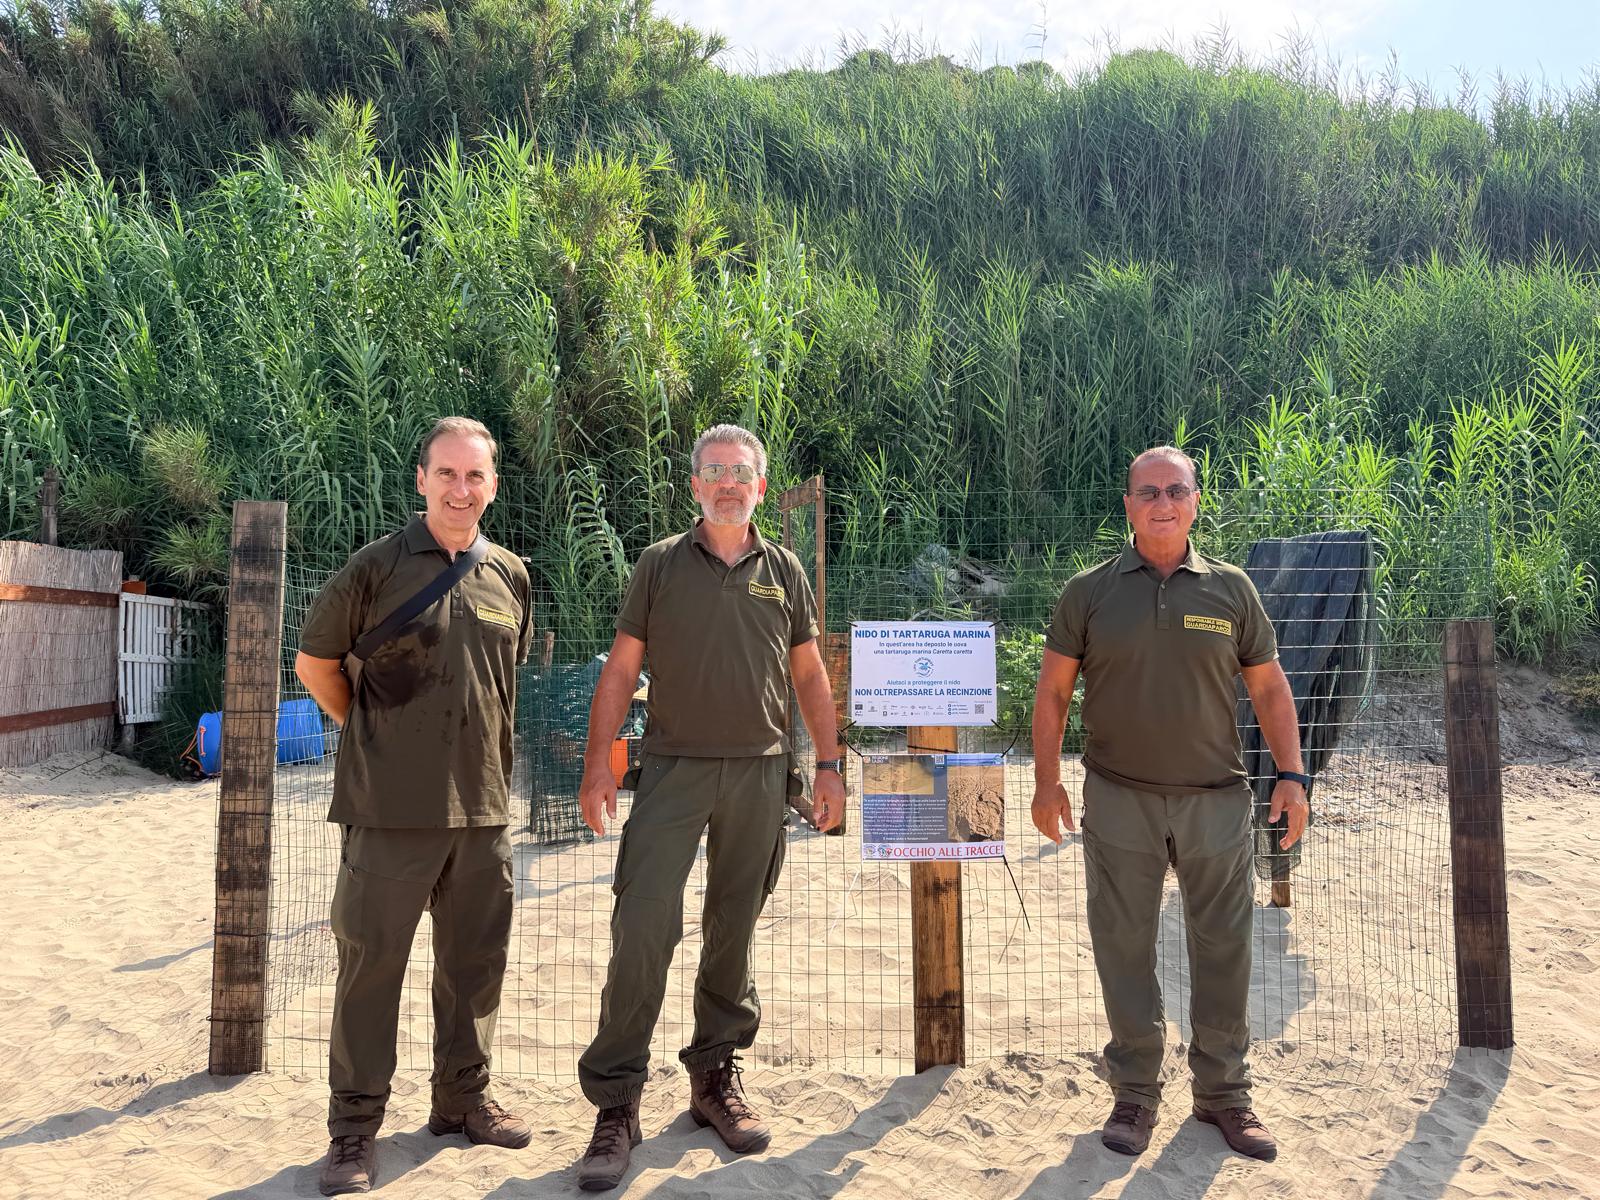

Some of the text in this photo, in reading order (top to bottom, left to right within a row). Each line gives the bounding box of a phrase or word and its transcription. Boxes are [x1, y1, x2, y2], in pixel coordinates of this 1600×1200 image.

[1186, 622, 1230, 632] GUARDIAPARCO
[855, 630, 991, 639] NIDO DI TARTARUGA MARINA
[855, 688, 992, 697] NON OLTREPASSARE LA RECINZIONE
[894, 847, 936, 857] OCCHIO
[938, 847, 963, 857] ALLE
[965, 845, 1004, 856] TRACCE!
